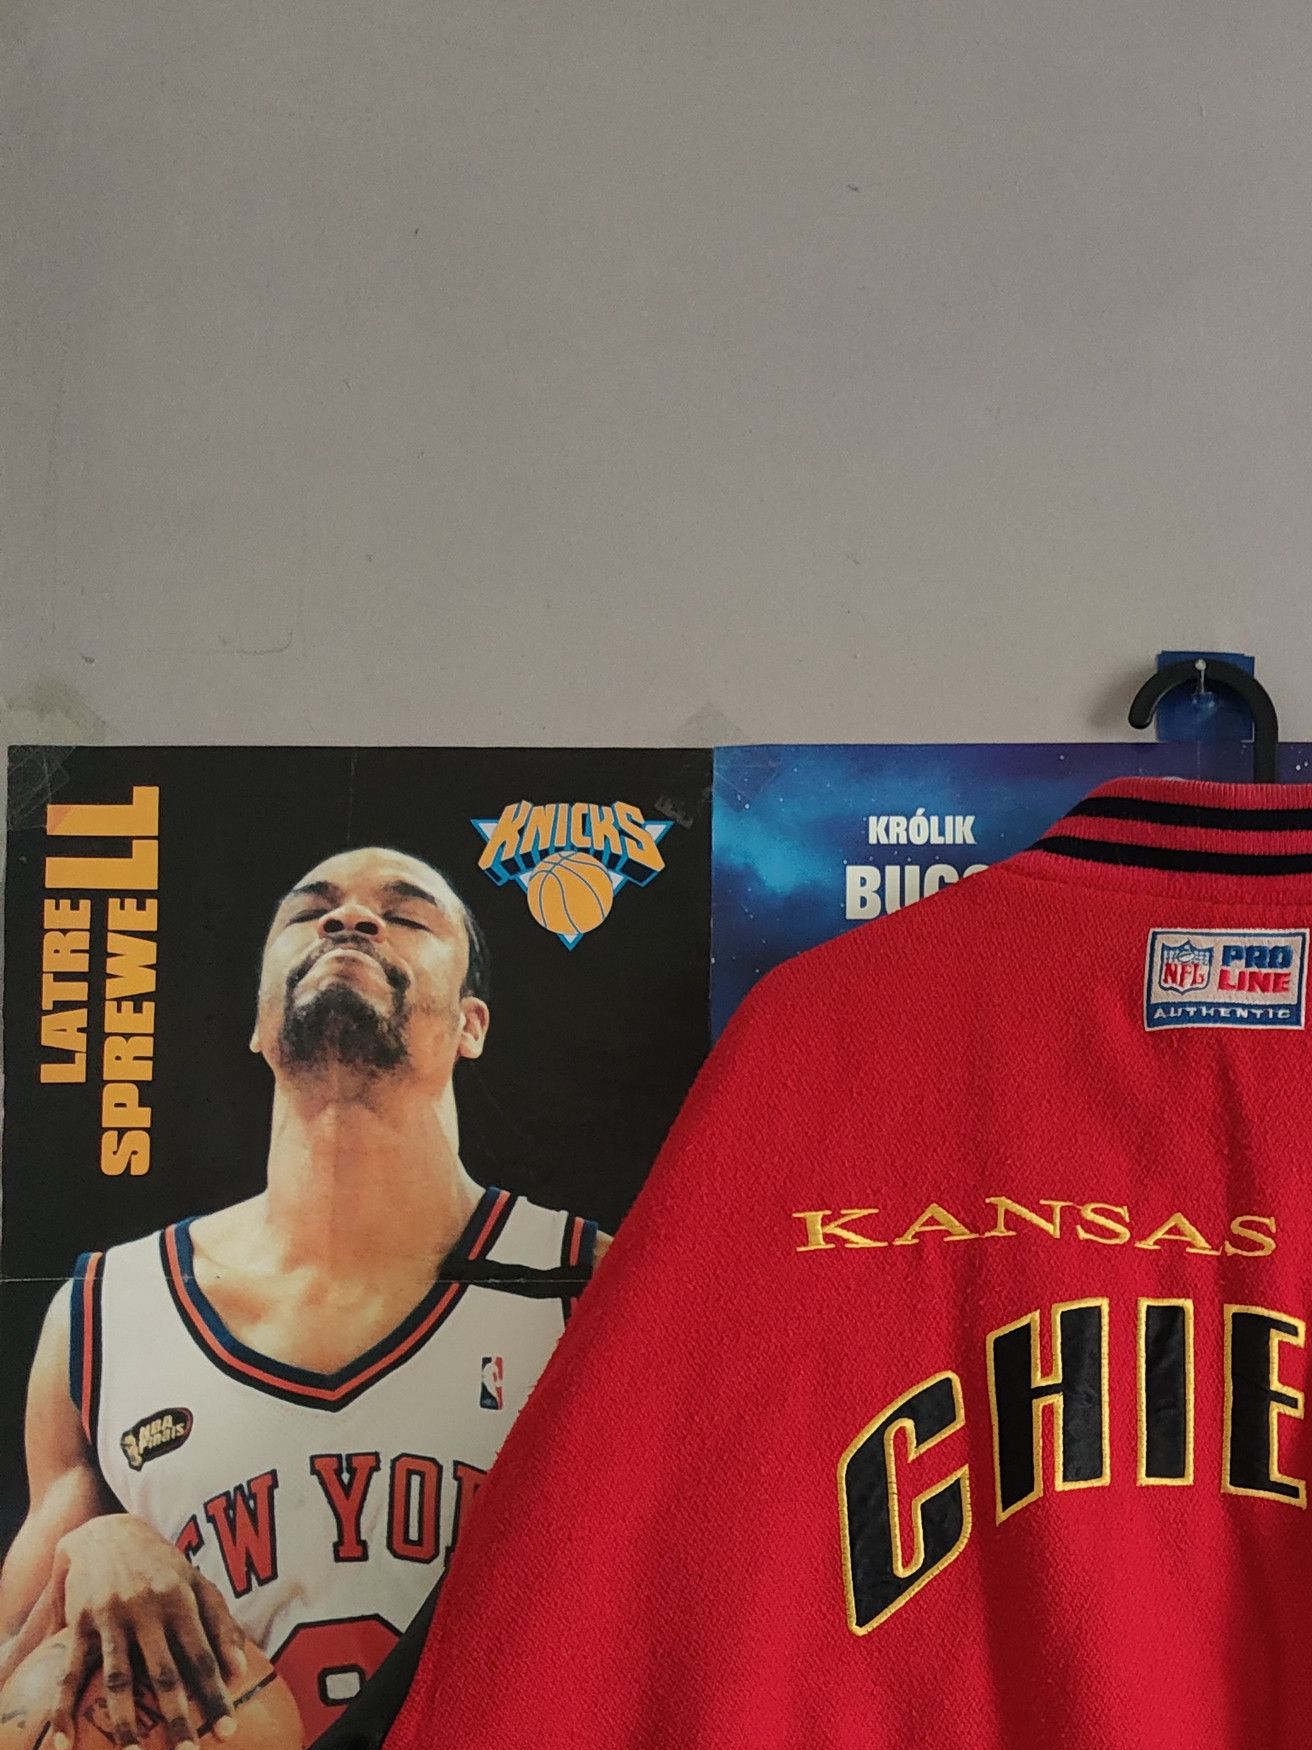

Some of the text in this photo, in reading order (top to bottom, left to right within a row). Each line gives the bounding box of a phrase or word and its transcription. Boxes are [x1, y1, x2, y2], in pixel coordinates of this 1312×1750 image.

[868, 807, 977, 845] KRÓLIK
[478, 800, 665, 879] KNICKS
[1222, 945, 1294, 968] PRO
[1163, 963, 1205, 988] NFL
[1218, 969, 1291, 993] LINE
[1153, 1006, 1291, 1019] AUTHENTIC
[792, 1196, 1278, 1257] KANSAS
[139, 1415, 174, 1440] NBA
